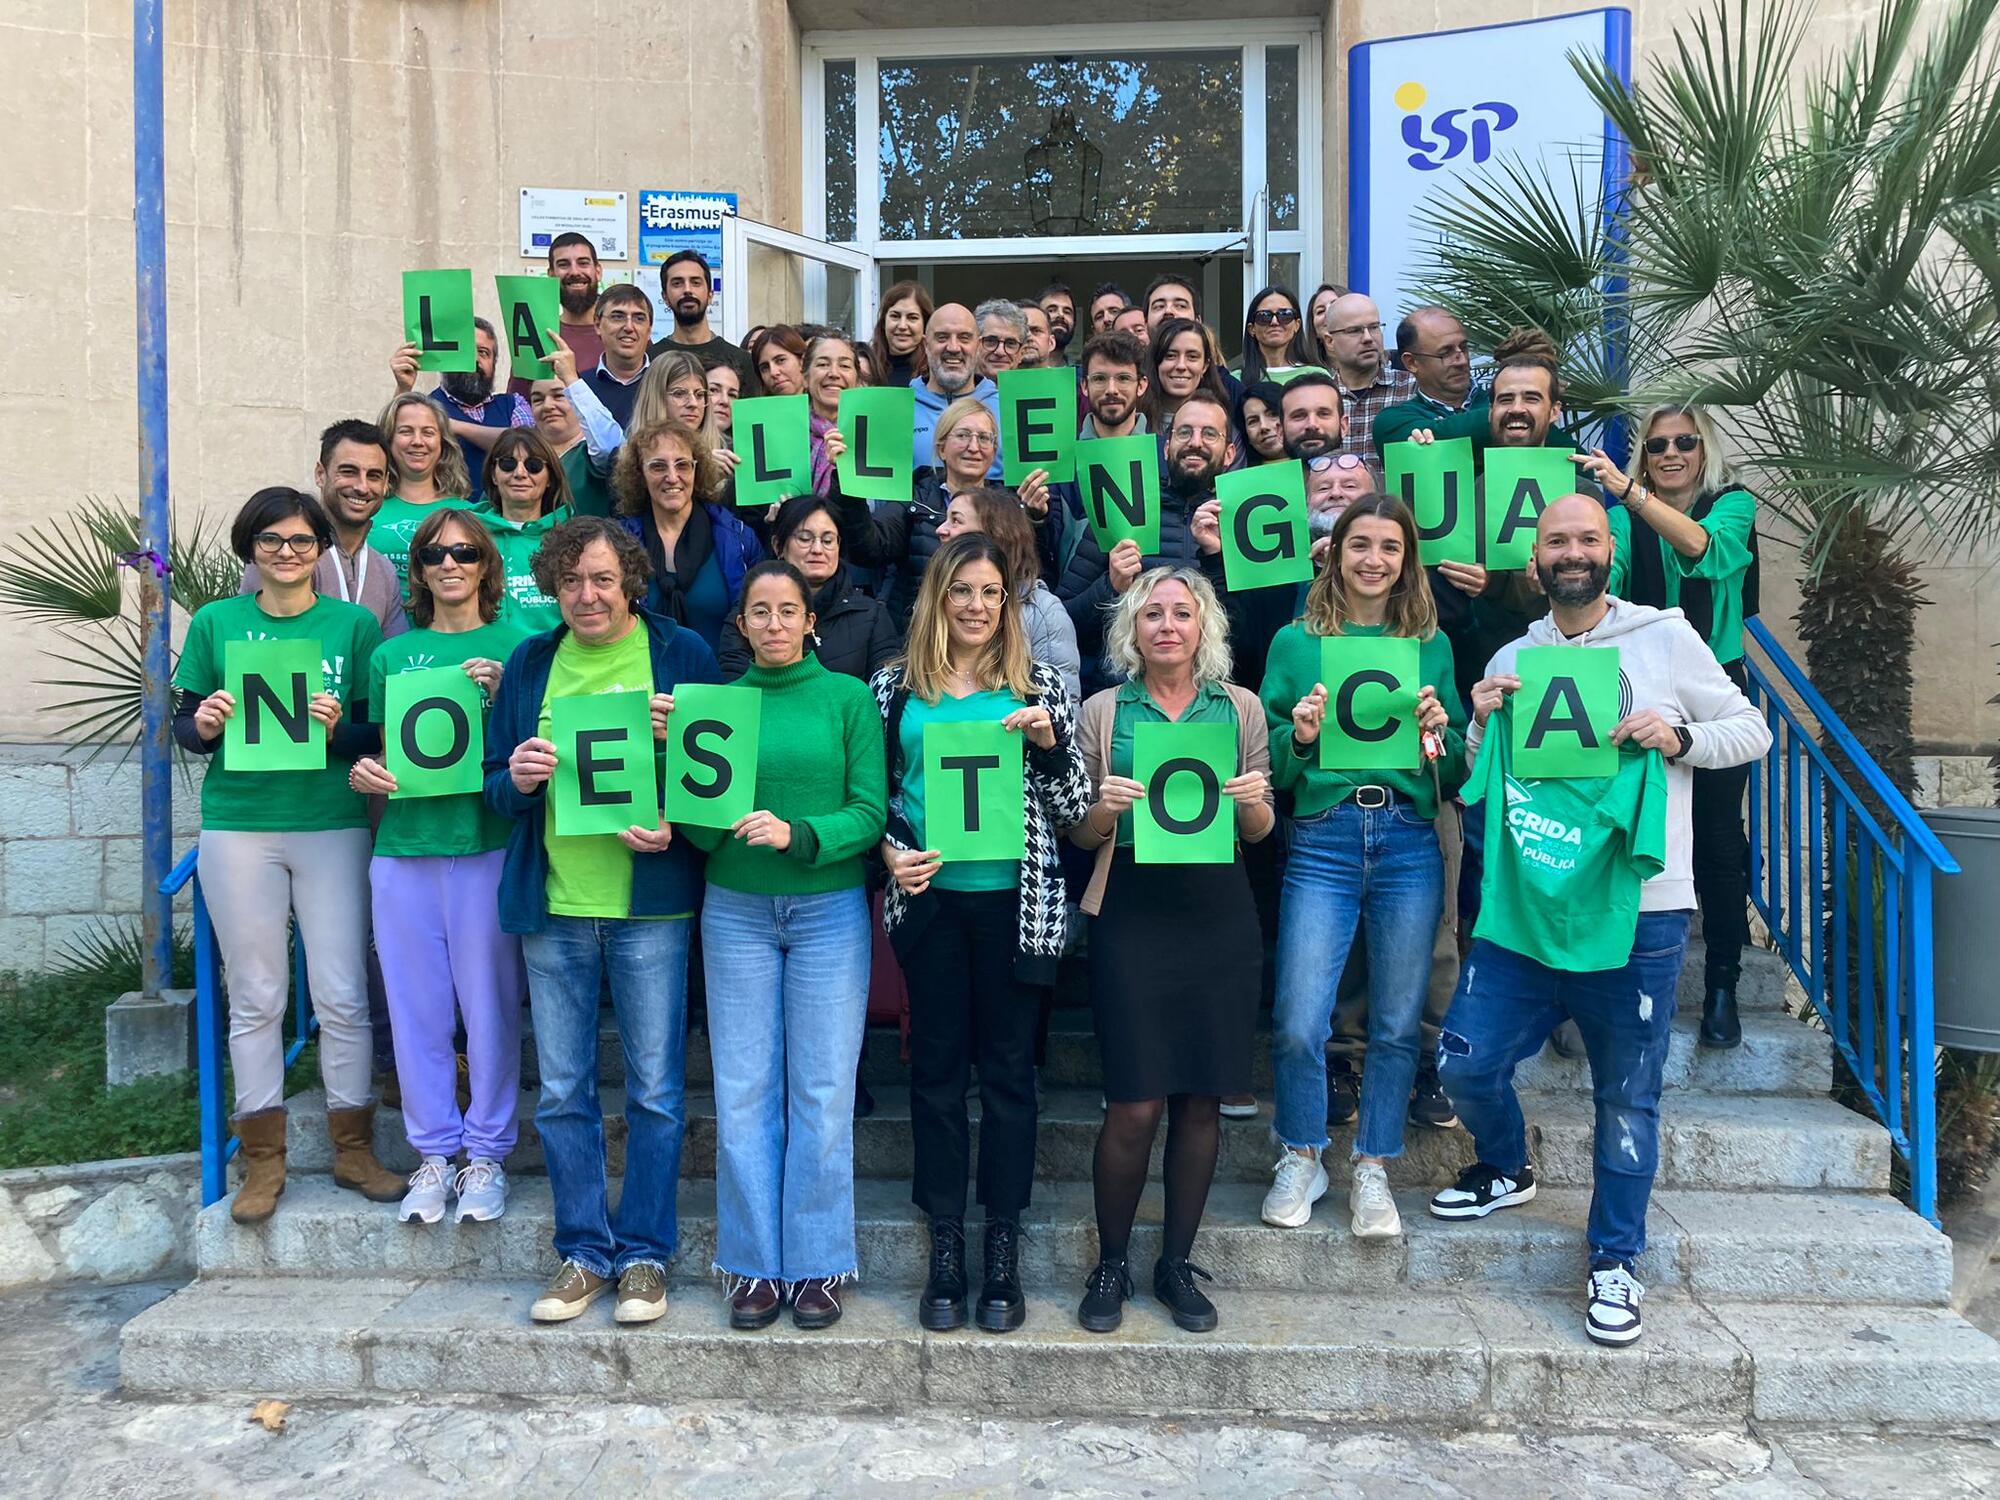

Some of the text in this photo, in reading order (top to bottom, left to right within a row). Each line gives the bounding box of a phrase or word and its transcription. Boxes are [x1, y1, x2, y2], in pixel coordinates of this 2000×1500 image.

[420, 295, 459, 352] L
[512, 302, 547, 360] A
[752, 423, 792, 483] L
[854, 415, 894, 478] L
[1016, 397, 1059, 463] E
[1089, 460, 1146, 529] N
[1233, 494, 1296, 563] G
[1401, 471, 1458, 541] U
[1496, 478, 1548, 544] A
[242, 672, 310, 745] N
[400, 696, 470, 770] O
[1335, 669, 1402, 743] C
[1524, 676, 1600, 749] A
[575, 727, 633, 806] E
[680, 720, 734, 799] S
[940, 755, 1000, 832] T
[1148, 757, 1220, 835] O
